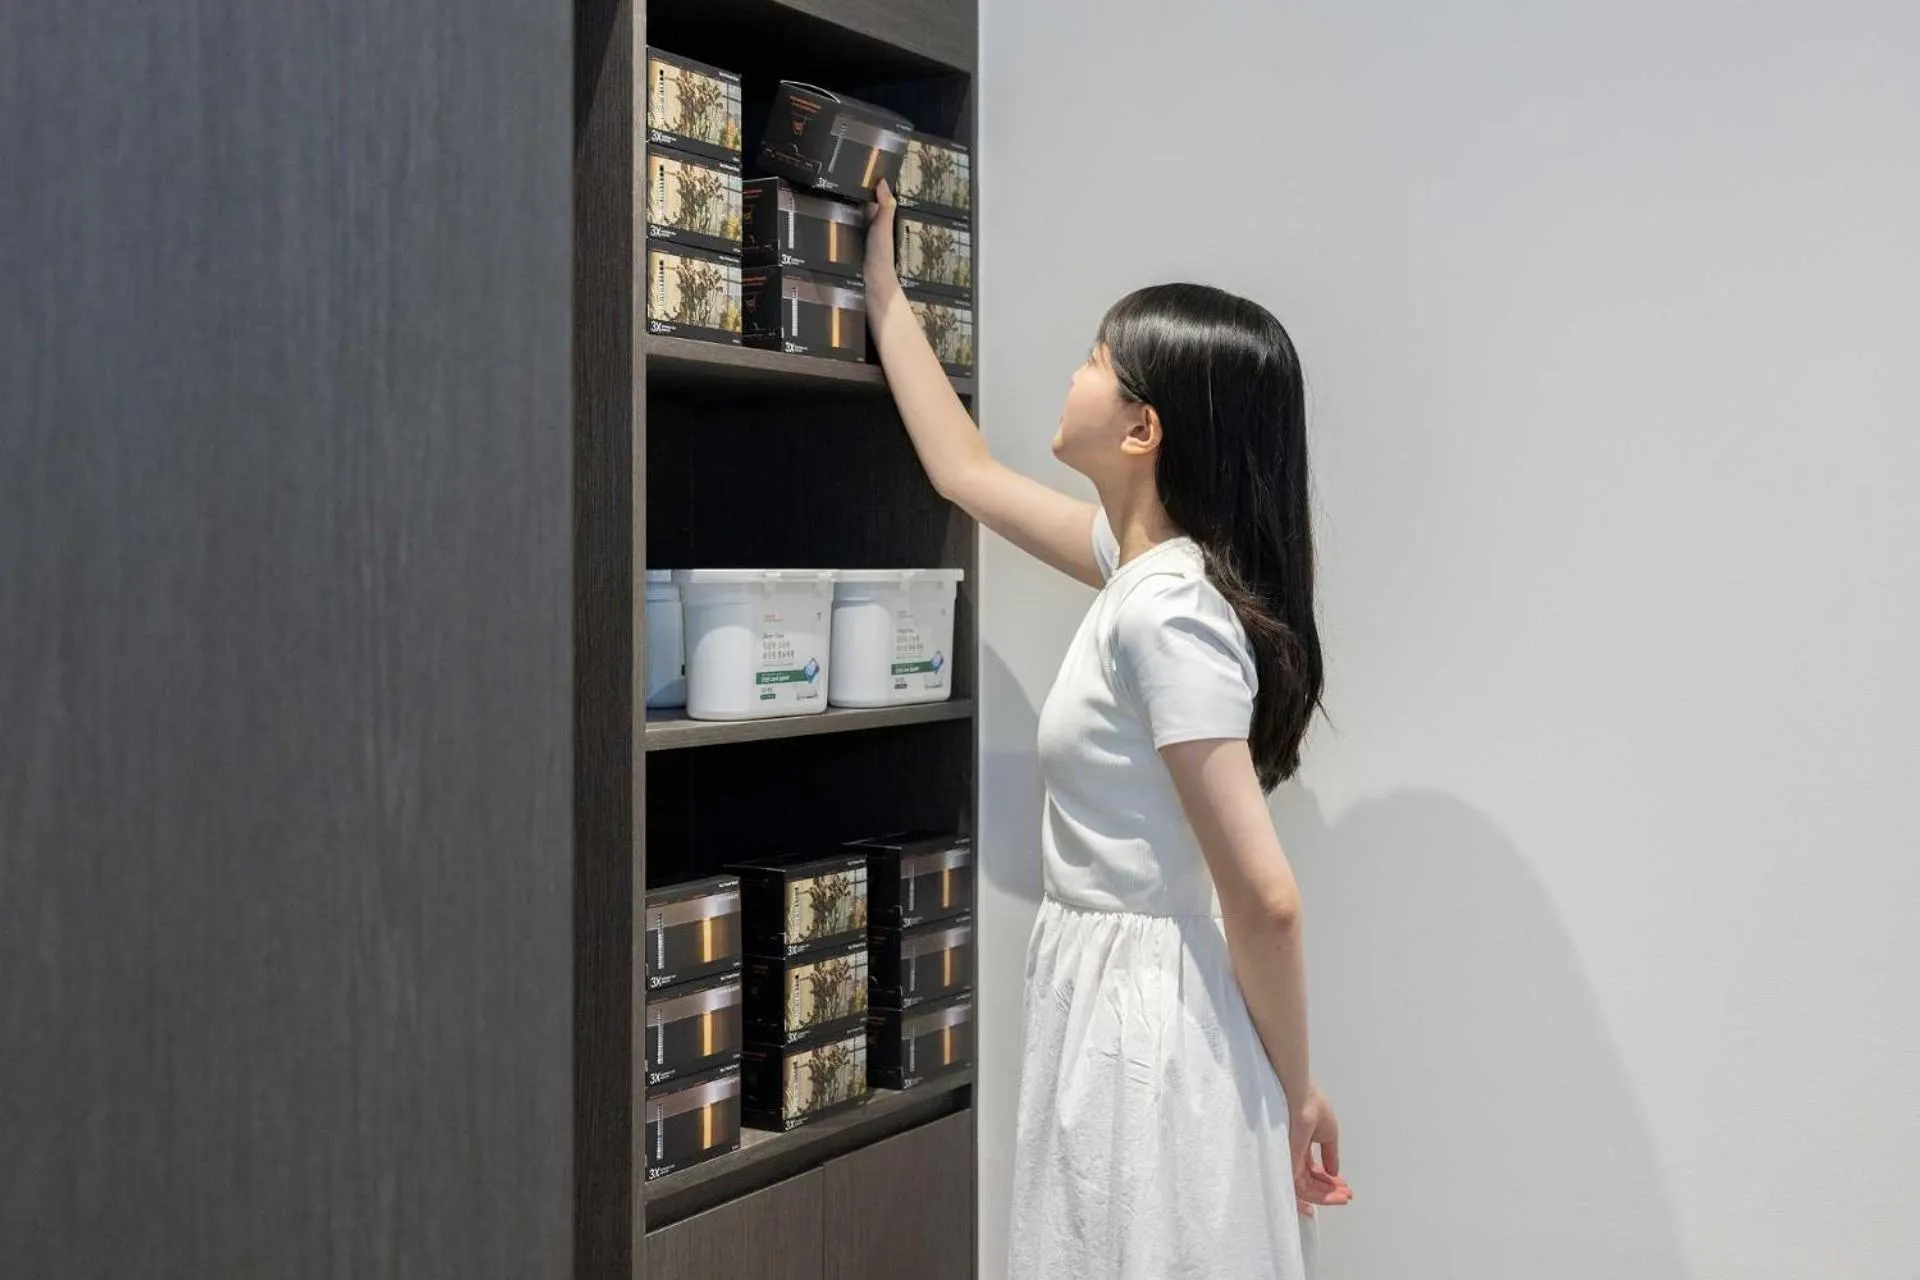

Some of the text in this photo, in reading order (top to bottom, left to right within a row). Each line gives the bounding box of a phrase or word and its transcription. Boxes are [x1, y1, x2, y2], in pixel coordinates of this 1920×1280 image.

[651, 320, 662, 332] 3X
[651, 976, 661, 988] 3X
[650, 1072, 661, 1084] 3X
[649, 1168, 660, 1179] 3X
